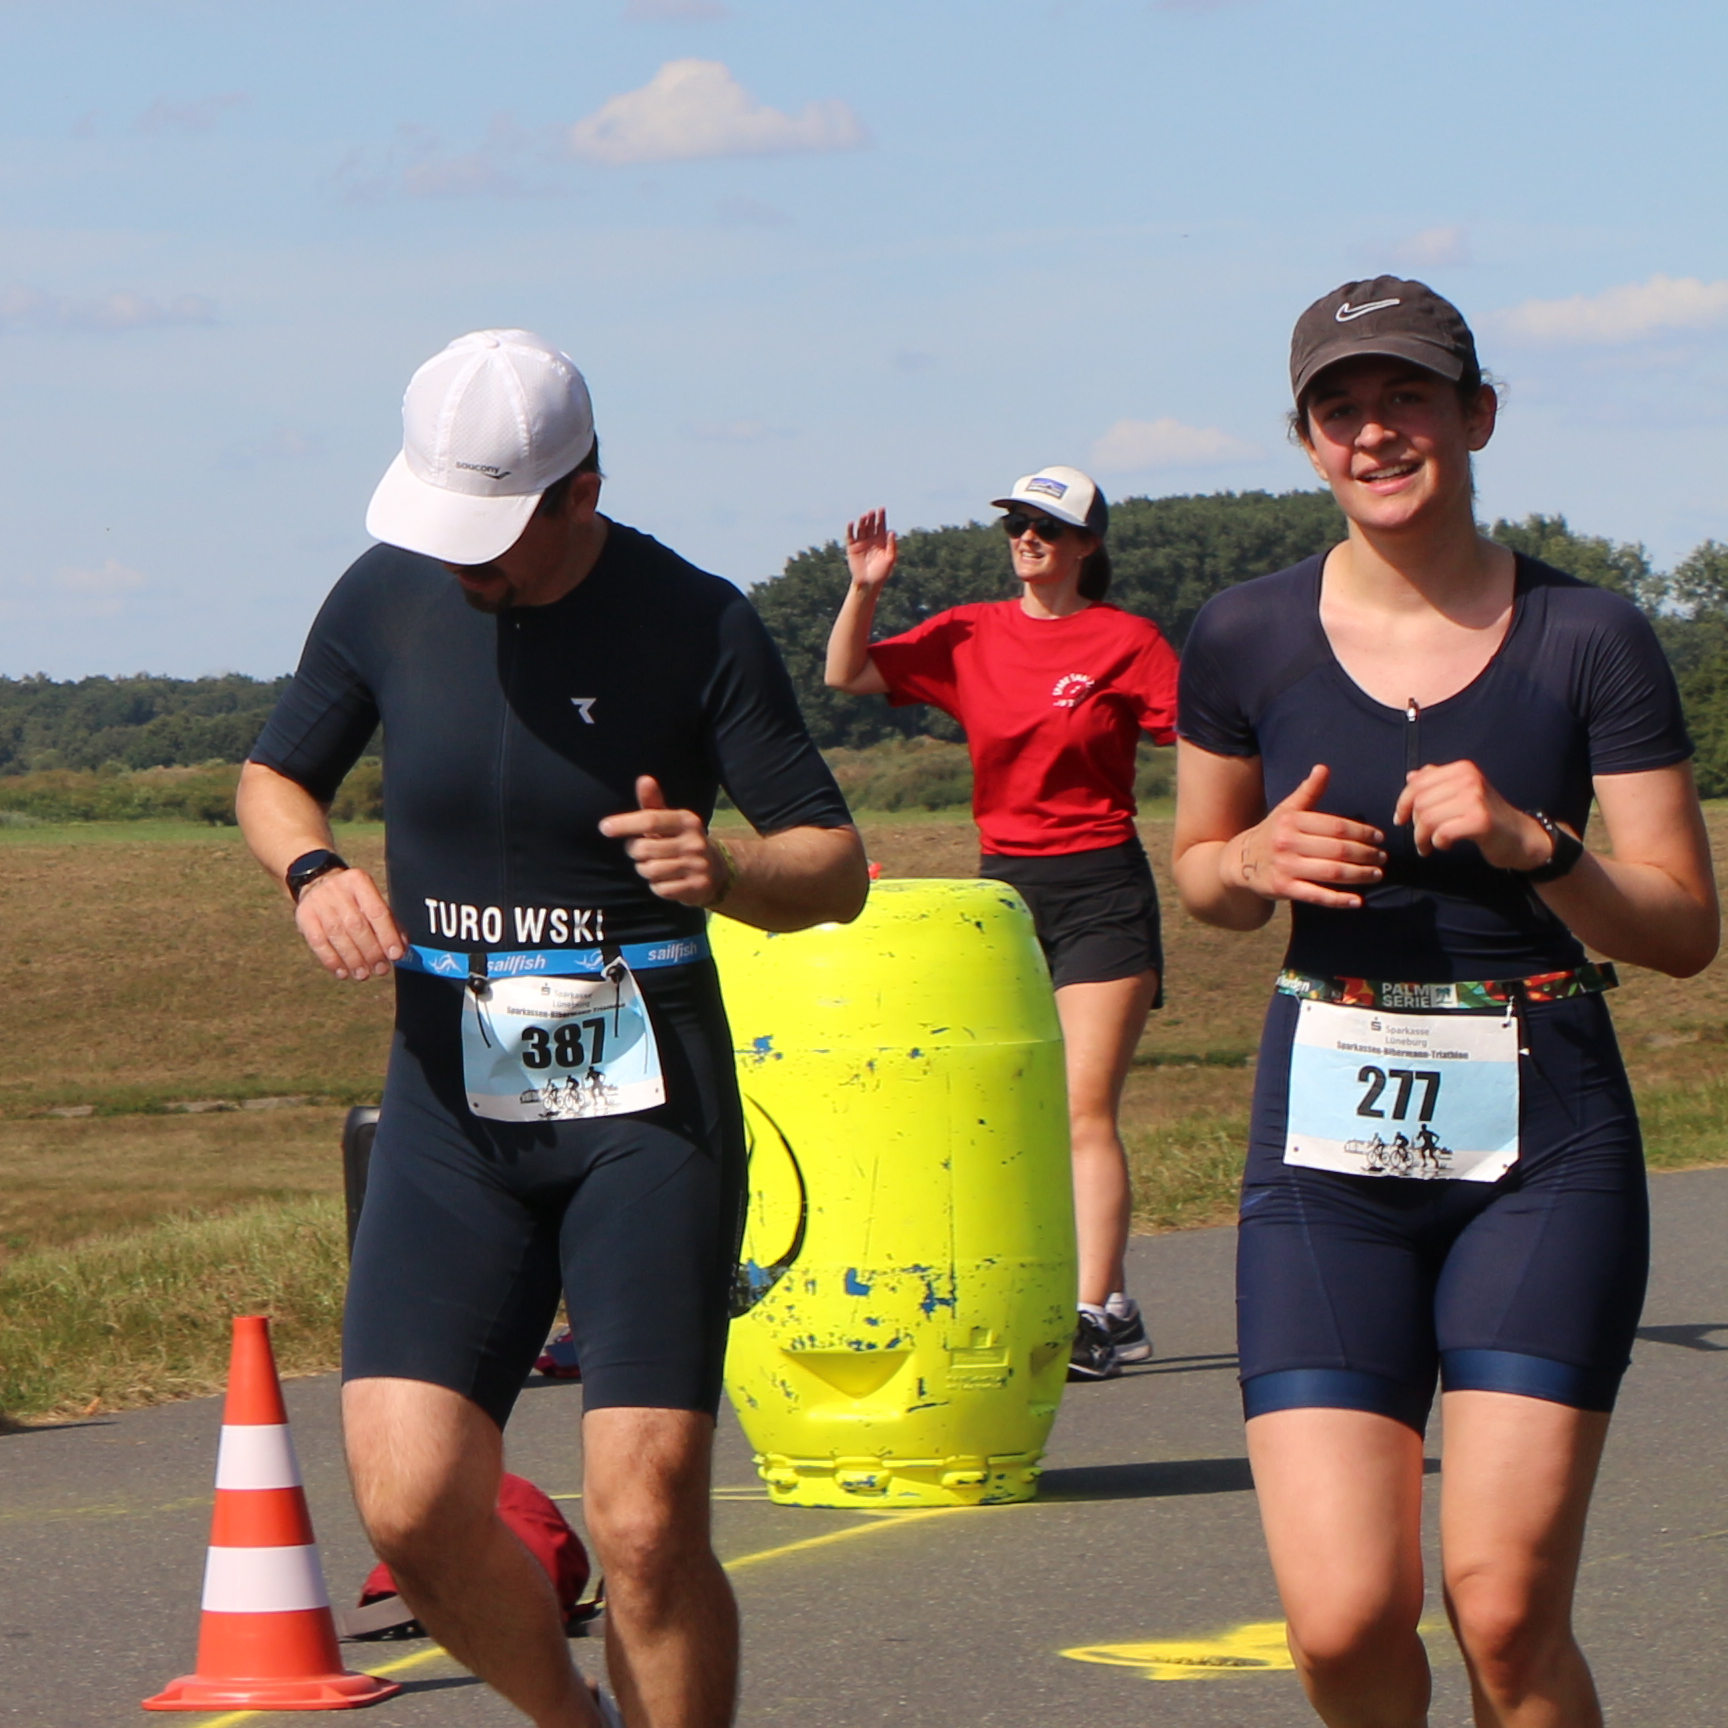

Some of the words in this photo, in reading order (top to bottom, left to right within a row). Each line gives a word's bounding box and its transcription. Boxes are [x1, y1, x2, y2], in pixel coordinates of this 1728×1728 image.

[647, 942, 697, 963] sailfish
[487, 954, 546, 975] sailfish
[1382, 982, 1430, 996] PALM
[1382, 994, 1430, 1008] SERIE
[1386, 1025, 1430, 1036] Sparkasse
[522, 1017, 605, 1069] 387
[1385, 1036, 1427, 1048] Lüneburg
[1356, 1065, 1440, 1122] 277
